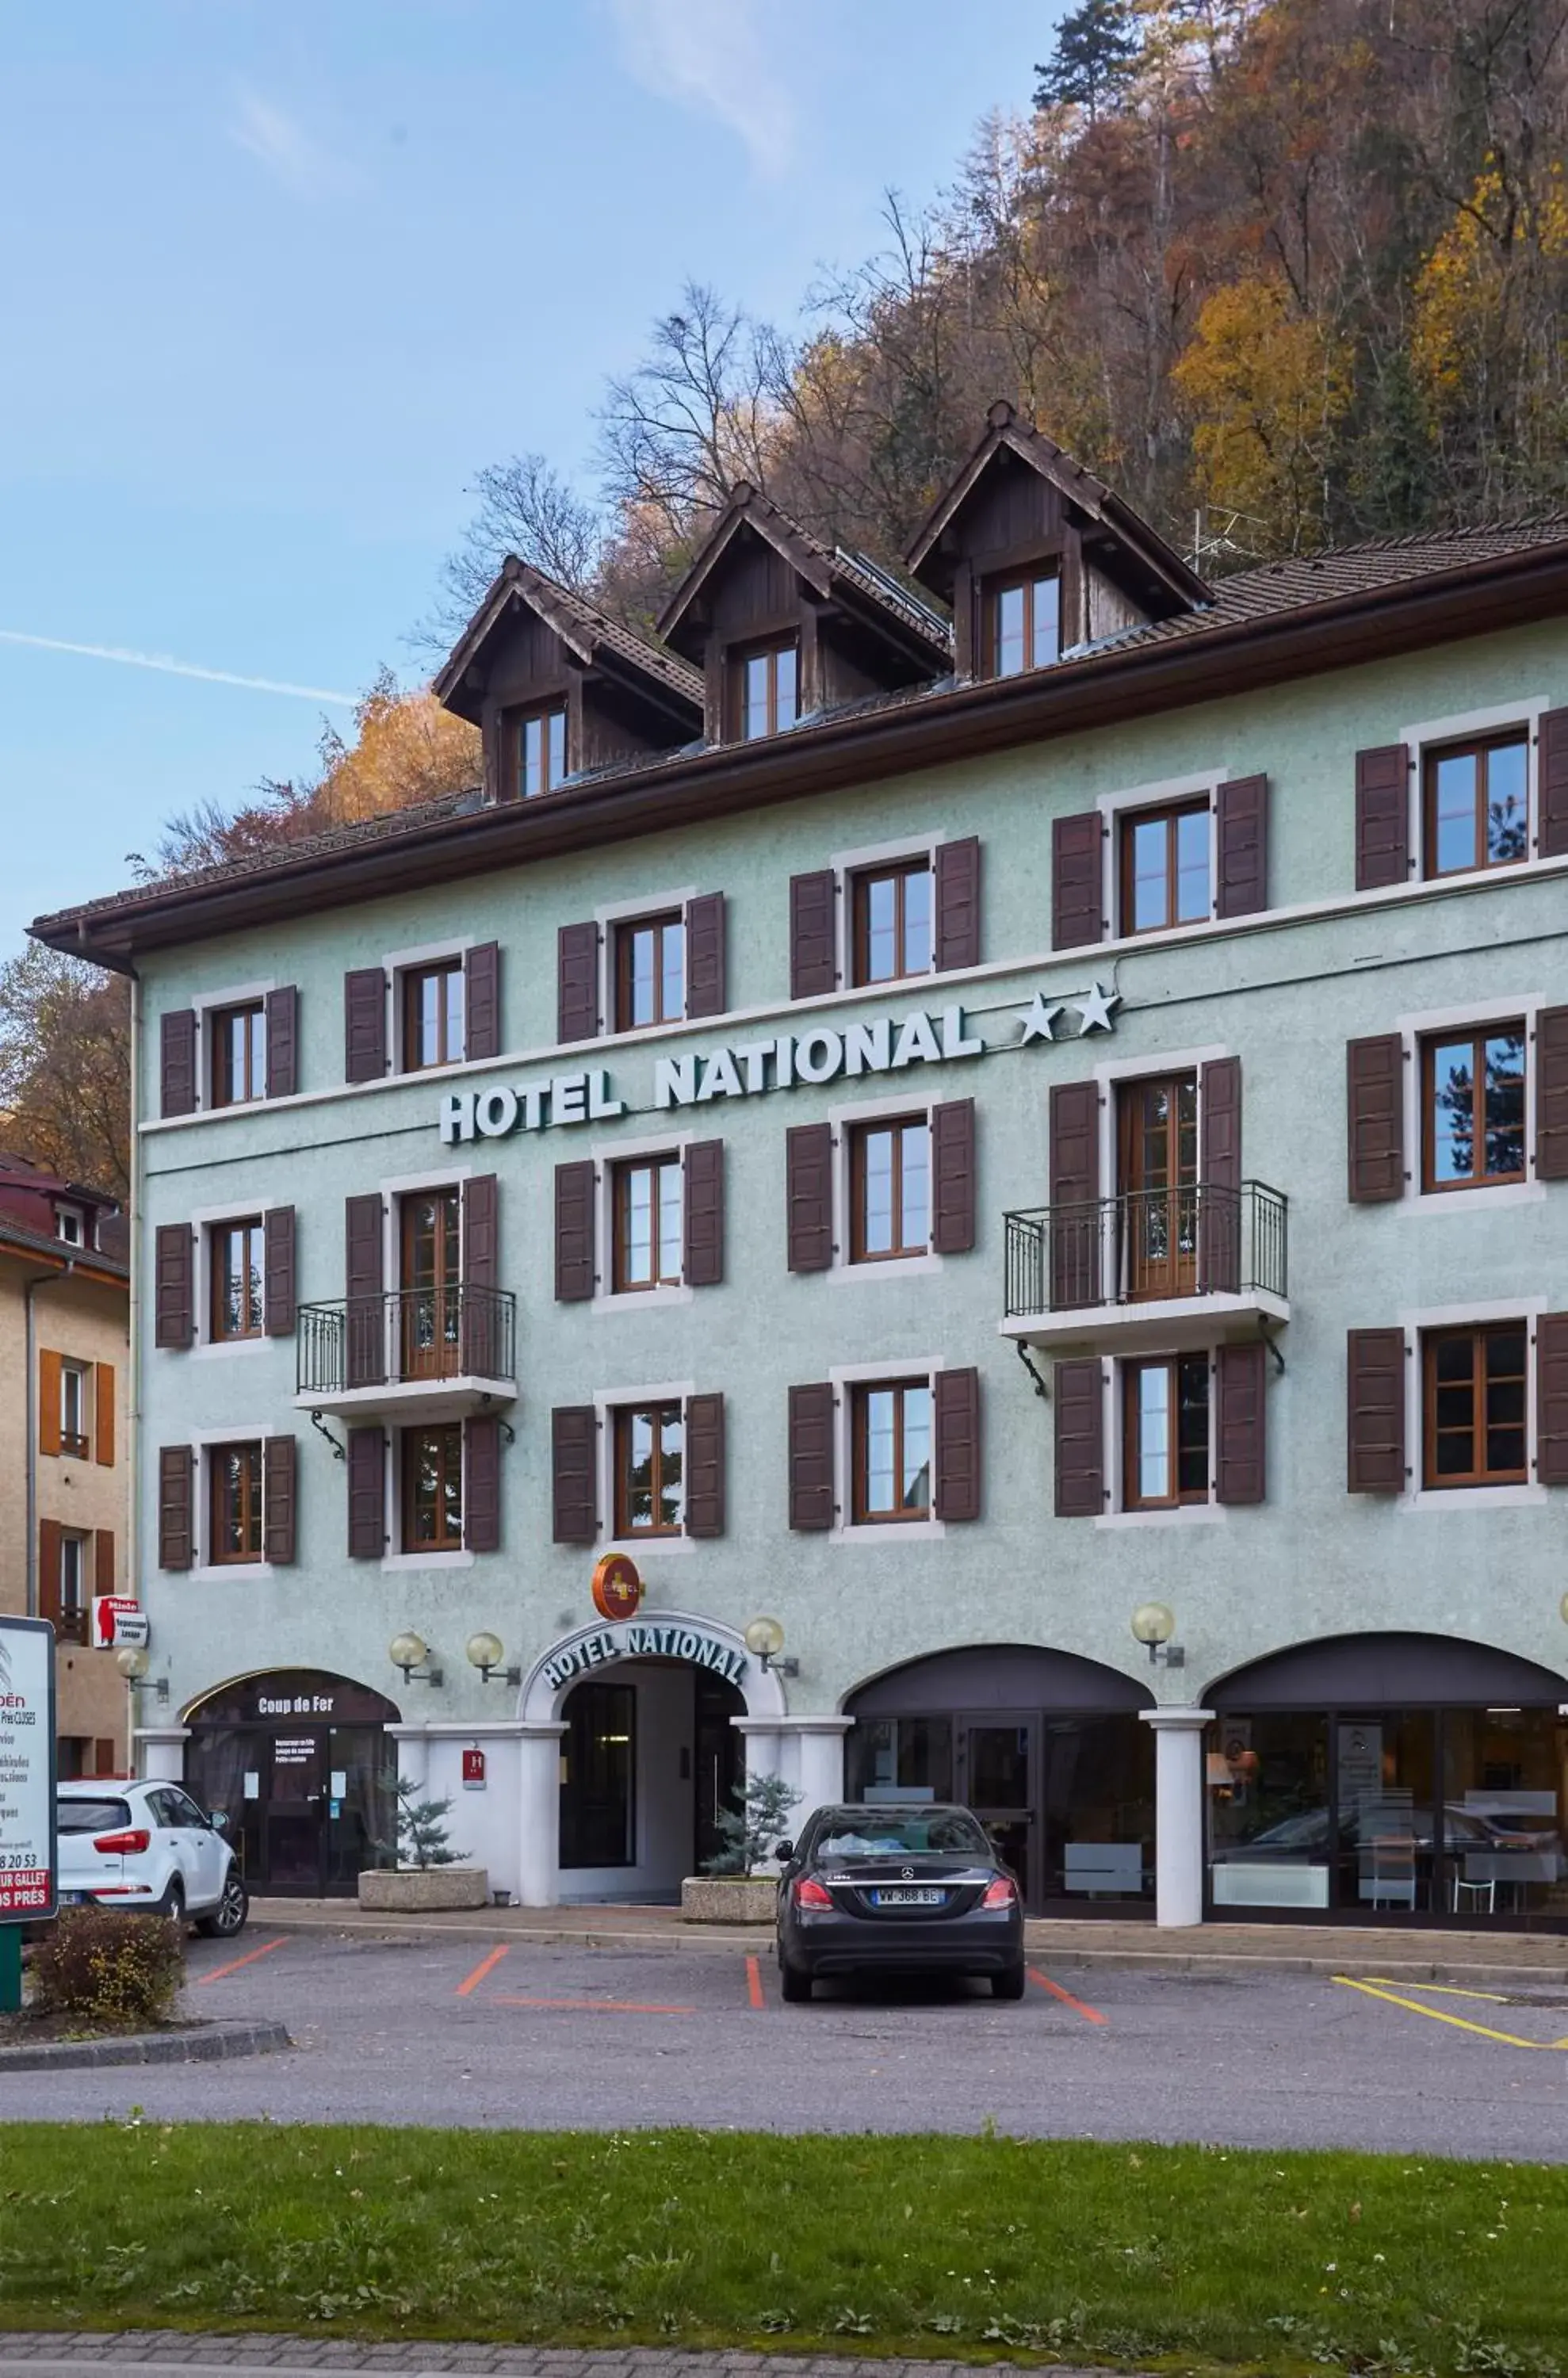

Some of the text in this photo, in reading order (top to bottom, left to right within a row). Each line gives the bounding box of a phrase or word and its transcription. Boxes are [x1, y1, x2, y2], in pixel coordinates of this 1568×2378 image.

[439, 1004, 985, 1145] HOTEL NATIONAL
[108, 1600, 137, 1611] Miele
[541, 1627, 749, 1691] HOTEL NATIONAL
[258, 1695, 335, 1715] Coup de Fer
[472, 1755, 482, 1768] H
[9, 1854, 21, 1868] 20
[25, 1853, 36, 1868] 53
[14, 1871, 47, 1887] GALLET
[13, 1887, 46, 1907] PRÉS
